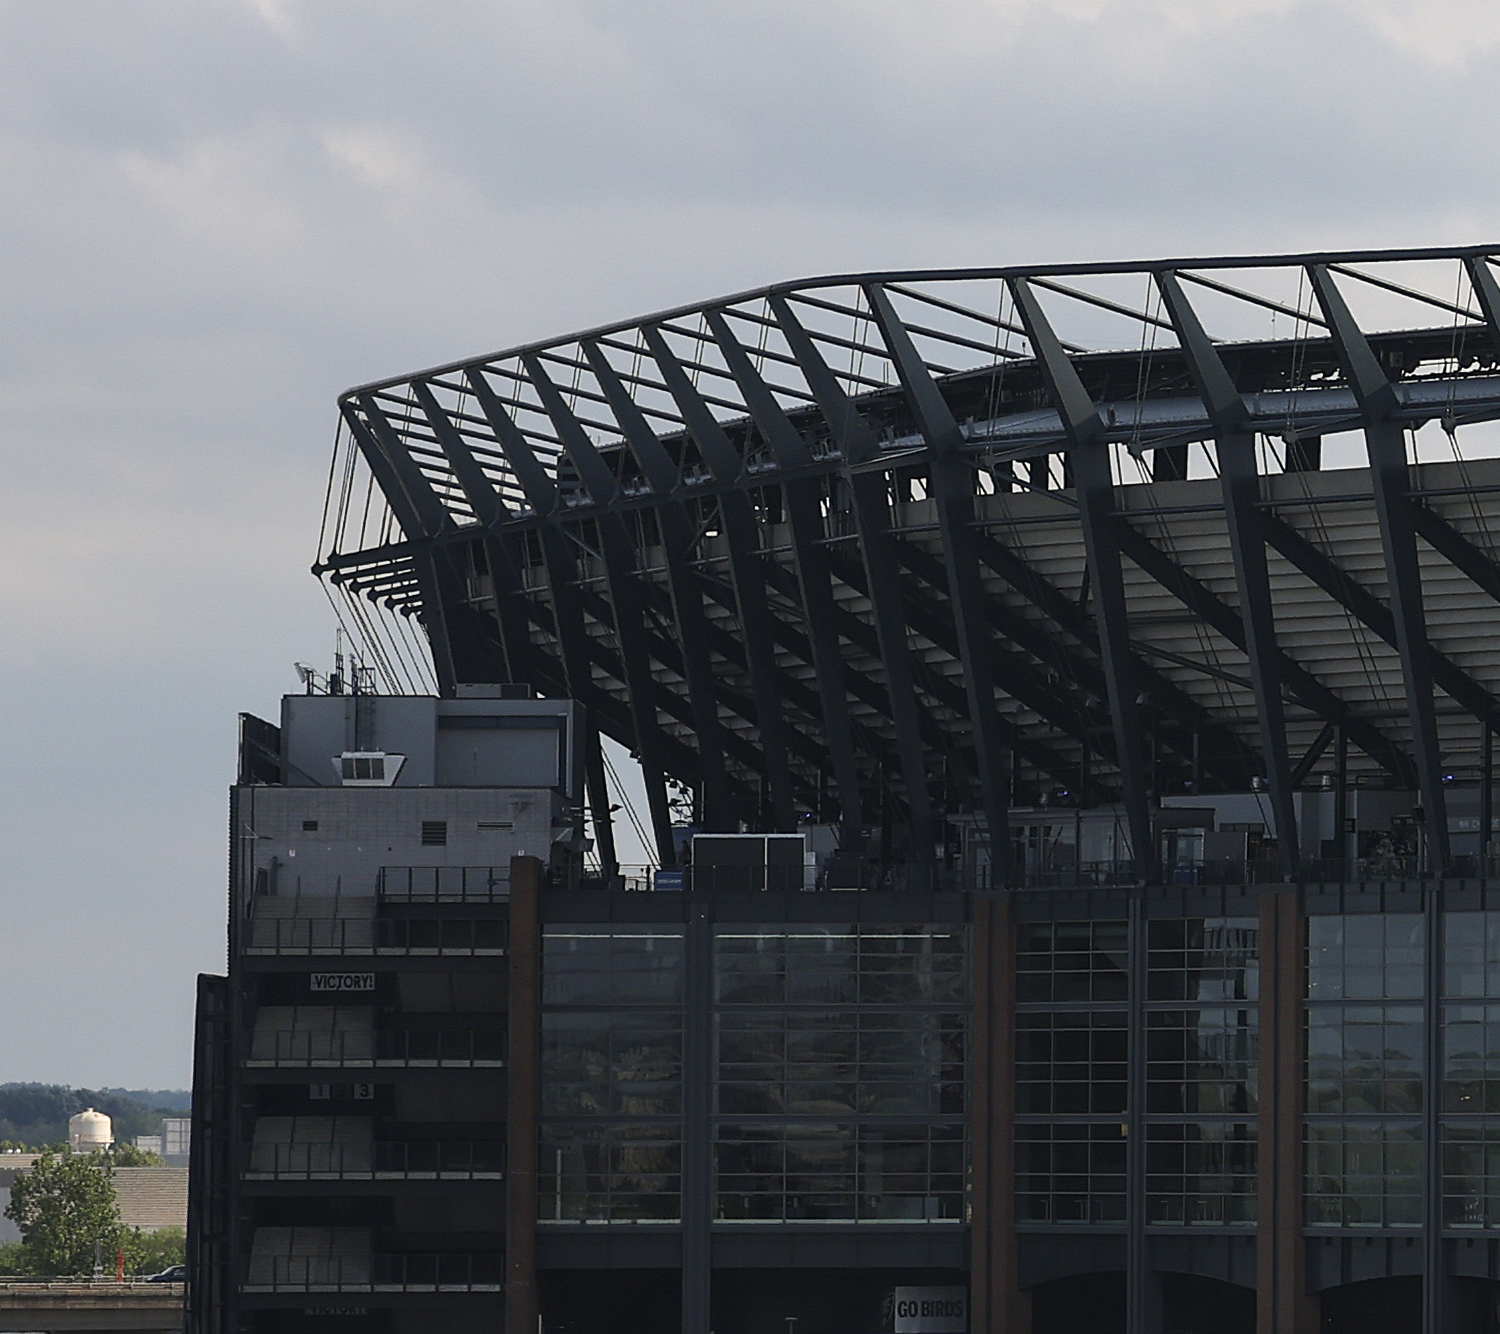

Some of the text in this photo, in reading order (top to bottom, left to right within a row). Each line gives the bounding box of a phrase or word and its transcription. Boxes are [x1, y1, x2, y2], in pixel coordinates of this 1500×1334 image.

[315, 974, 374, 990] VICTORY!
[898, 1301, 963, 1318] GO BIRDS
